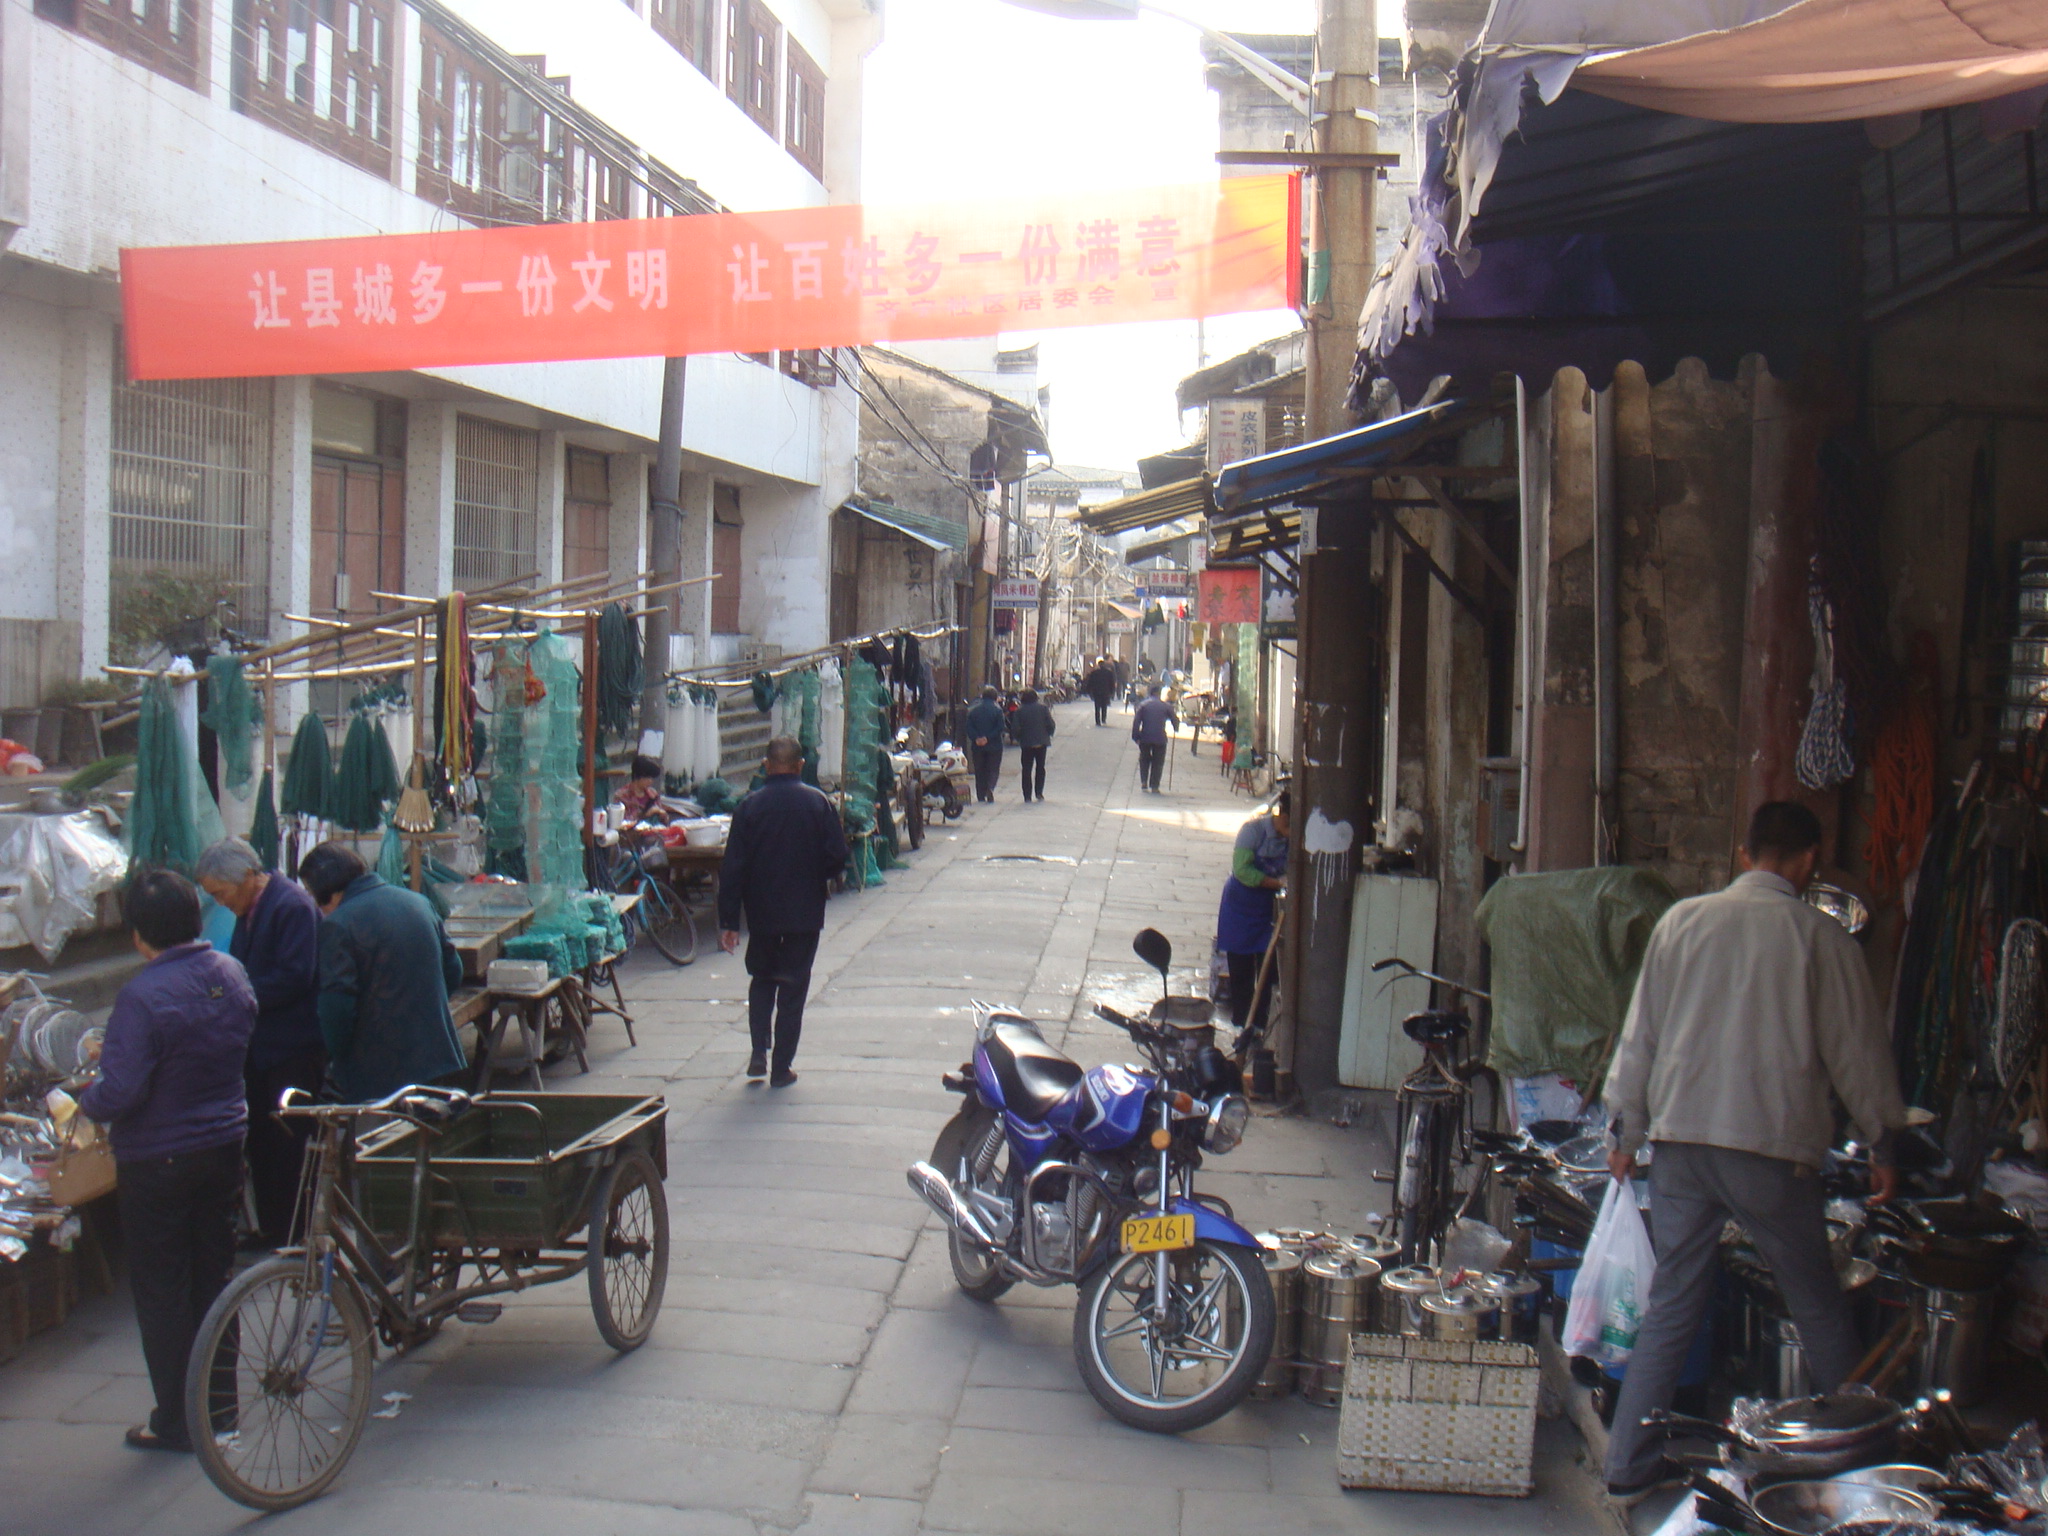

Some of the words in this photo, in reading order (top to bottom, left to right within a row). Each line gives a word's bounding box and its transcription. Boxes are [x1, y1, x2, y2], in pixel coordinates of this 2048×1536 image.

[248, 249, 668, 329] 让县城多一份文明
[727, 215, 1181, 303] 让百姓多一份满意
[1241, 411, 1257, 456] 皮衣系列
[1125, 1217, 1187, 1245] P2461
